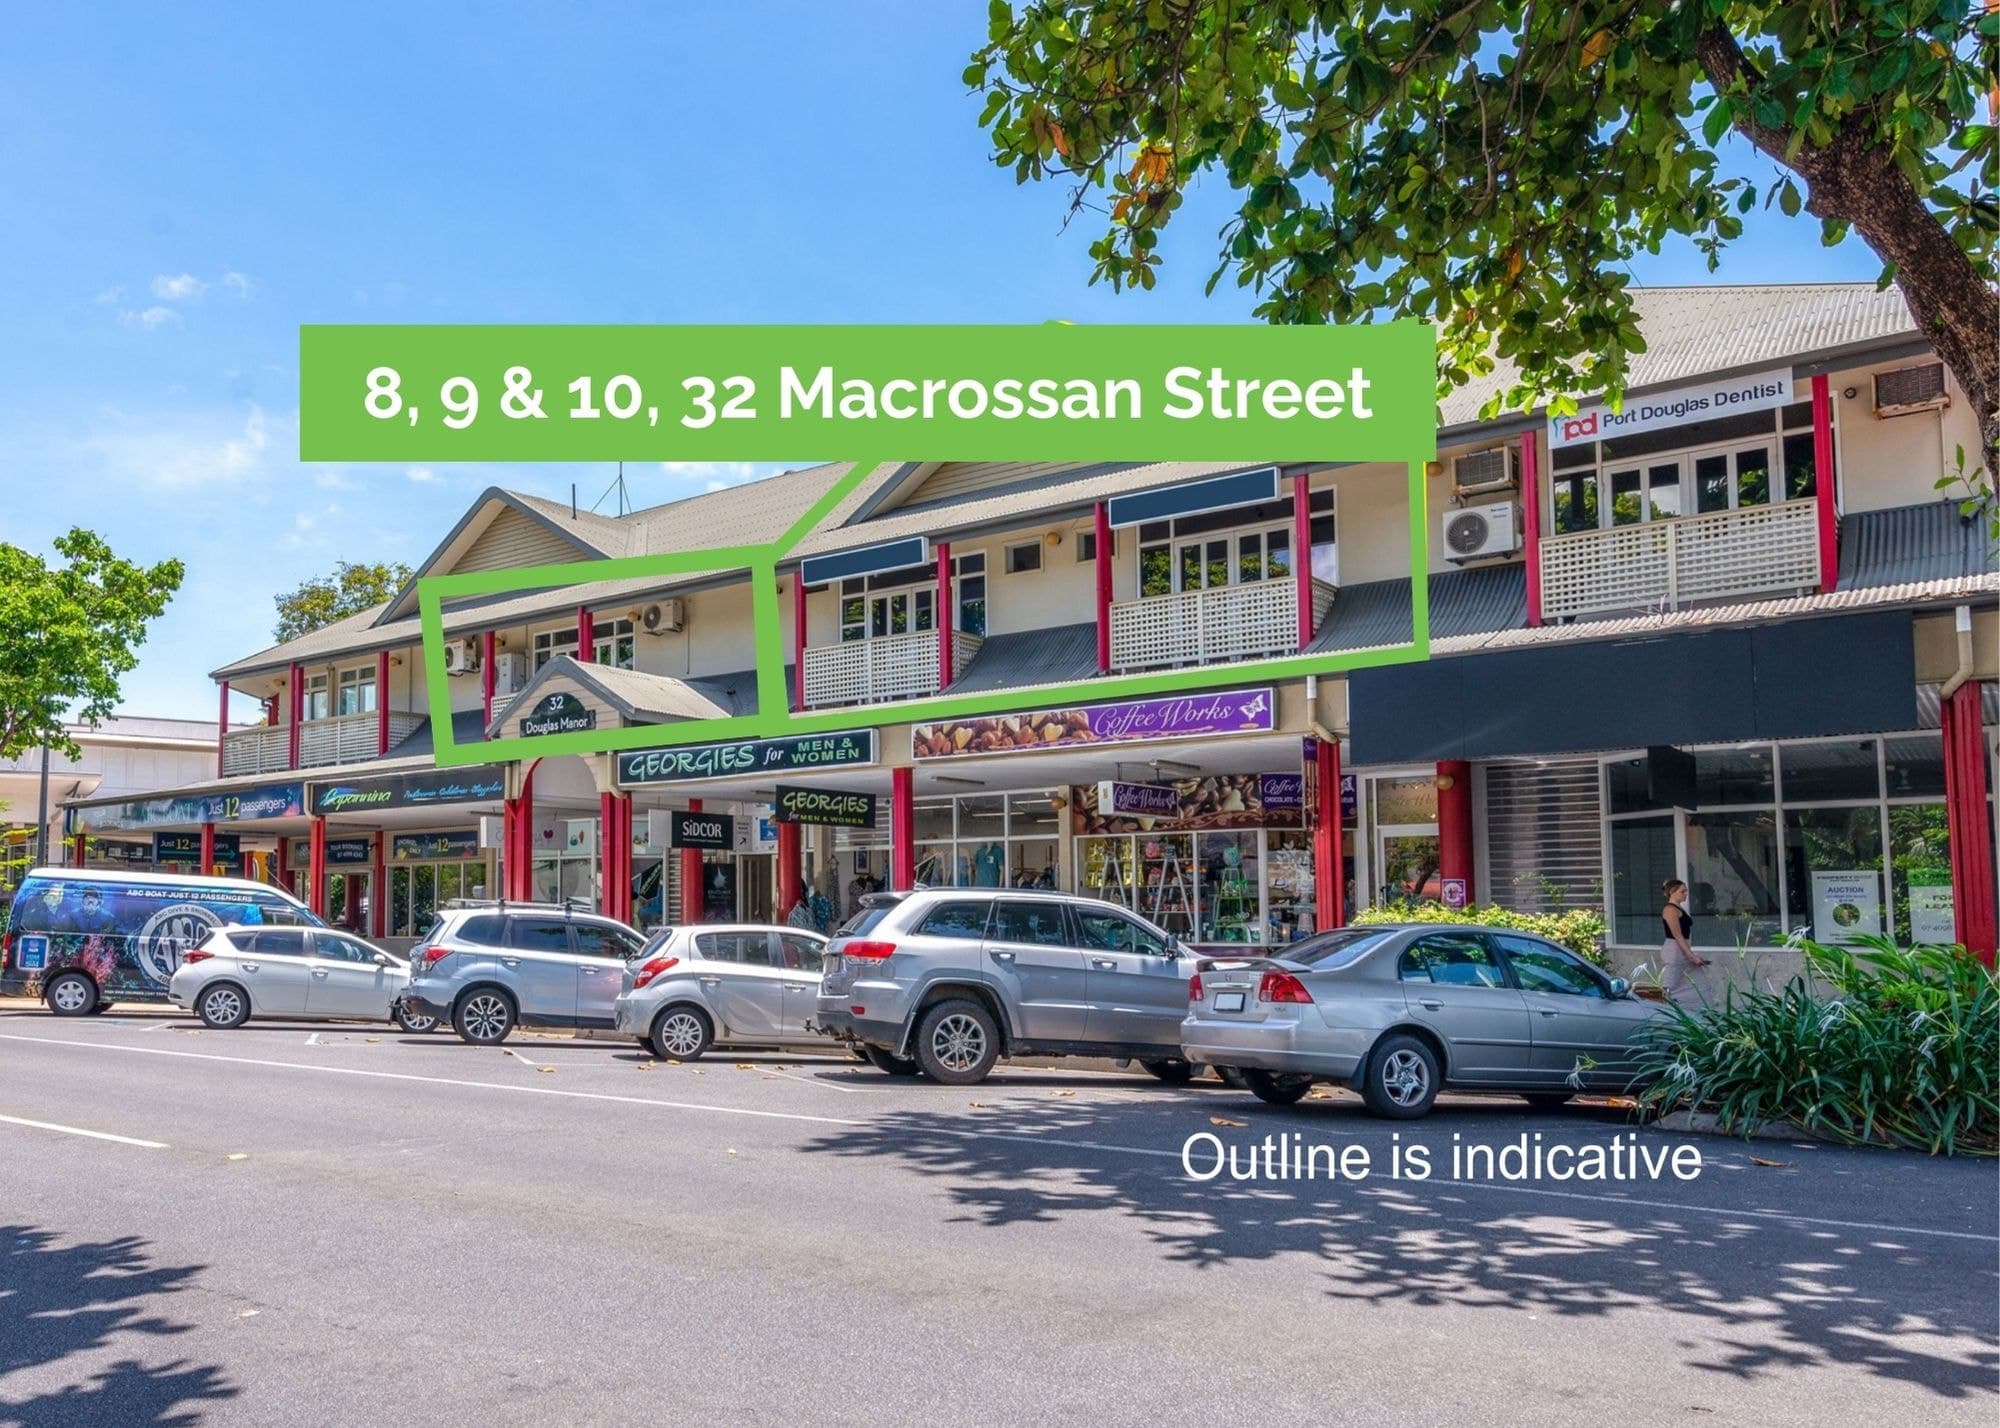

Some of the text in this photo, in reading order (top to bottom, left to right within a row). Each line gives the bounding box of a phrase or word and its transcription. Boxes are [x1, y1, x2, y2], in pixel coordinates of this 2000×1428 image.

[1603, 381, 1784, 428] Port Douglas Dentist
[550, 695, 564, 710] 32
[1094, 697, 1234, 737] Coffee Works
[526, 717, 588, 735] Douglas Manor
[798, 737, 853, 751] MEN &
[628, 745, 784, 781] GEORGIES for
[791, 748, 860, 764] WOMEN
[1263, 778, 1294, 795] Coffee
[208, 796, 286, 818] Just 12 passengers
[783, 791, 869, 814] GEORGIES
[830, 816, 864, 824] WOMEN
[176, 838, 190, 850] 12
[437, 838, 449, 852] 12
[127, 889, 144, 897] ABC
[145, 890, 167, 898] BOAT
[168, 891, 189, 899] JUST
[200, 892, 253, 902] PASSENGERS
[1827, 886, 1865, 894] AUCTION
